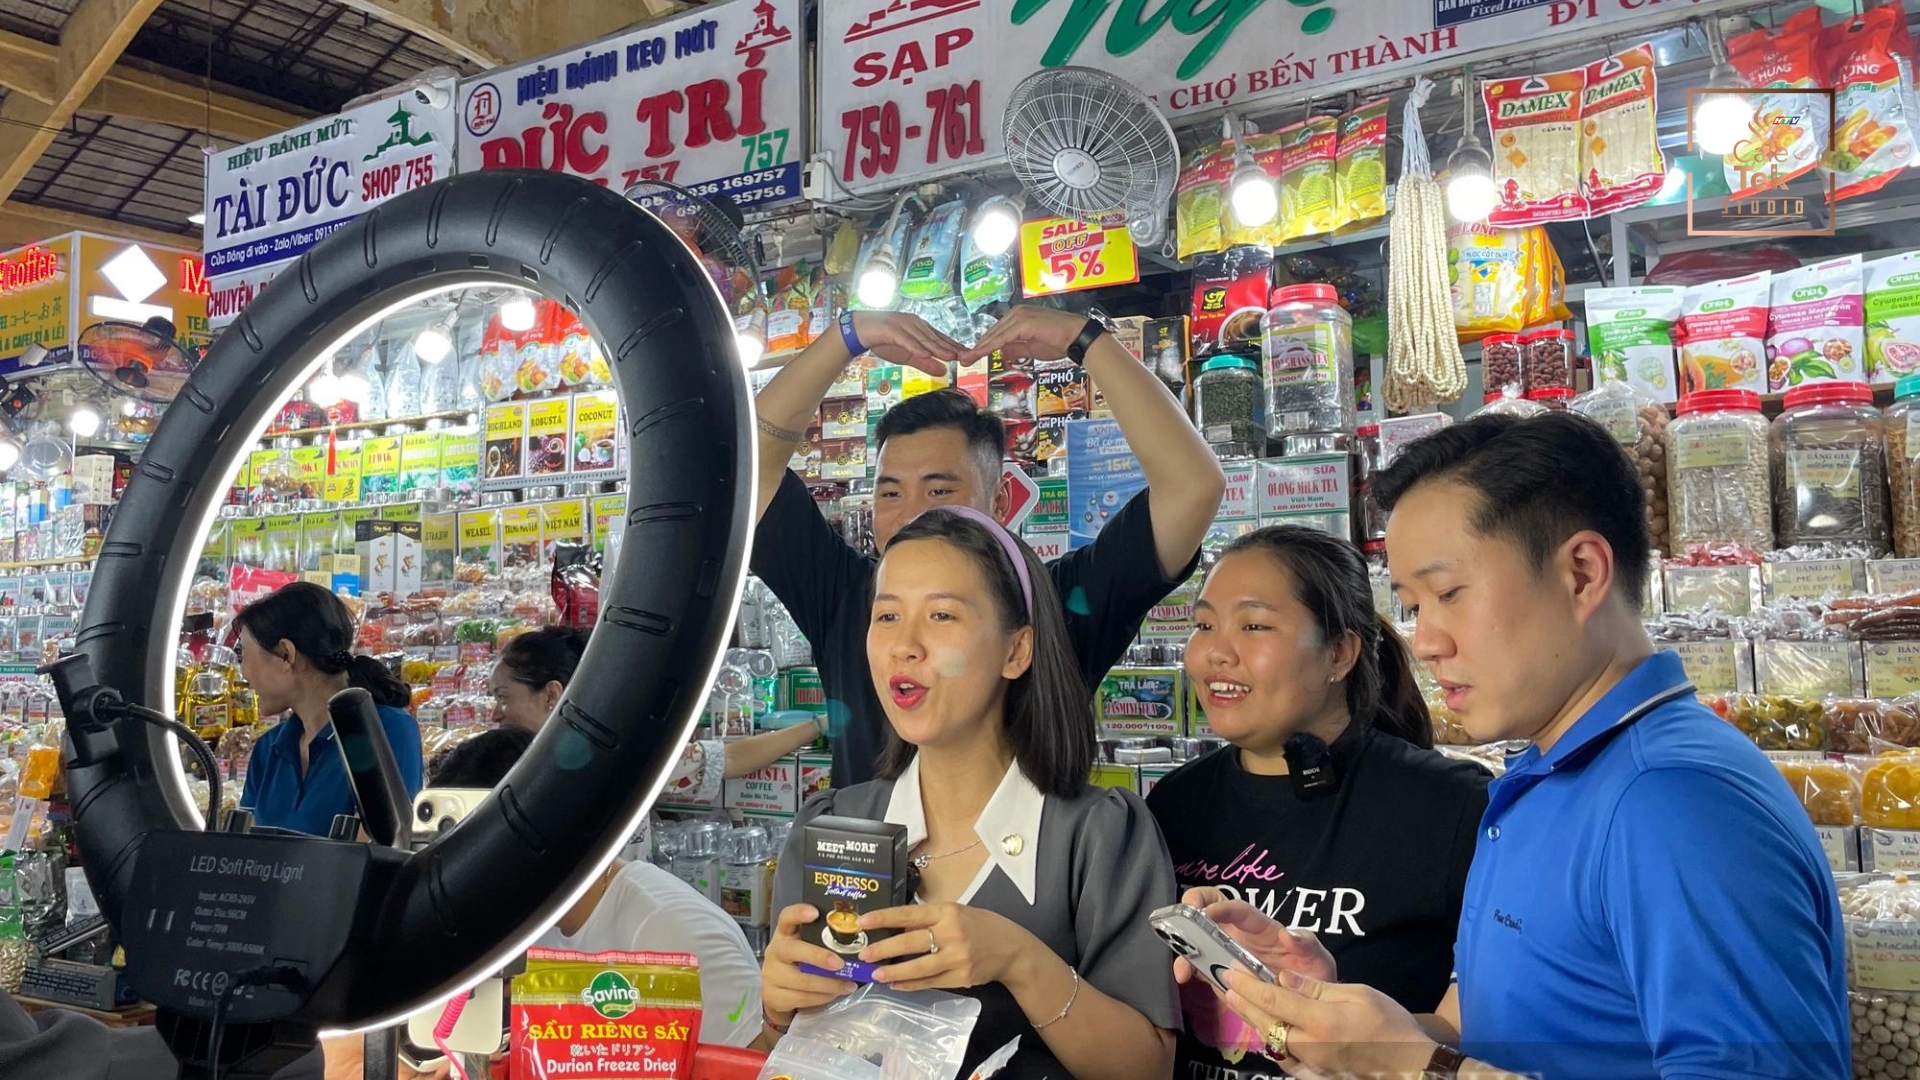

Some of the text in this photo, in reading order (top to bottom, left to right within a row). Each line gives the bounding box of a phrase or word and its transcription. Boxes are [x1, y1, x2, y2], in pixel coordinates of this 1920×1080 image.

[851, 28, 974, 86] SẠP
[1169, 26, 1459, 107] CHỢ BẾN THÀNH
[566, 51, 617, 90] BÁNH
[1585, 69, 1641, 104] DAMEX
[1501, 92, 1569, 117] DAMEX
[227, 118, 353, 170] HIỆU BÁNH MỨT
[741, 128, 790, 173] 757
[361, 154, 433, 202] SHOP 755
[723, 168, 787, 191] 169757
[213, 156, 350, 238] TÀI ĐỨC
[1042, 222, 1088, 239] SALE
[1052, 233, 1088, 252] OFF
[8, 246, 57, 289] coffee
[1051, 249, 1105, 284] 5%
[1204, 290, 1226, 304] G7
[1050, 368, 1074, 384] PHỐ
[488, 419, 523, 432] HIGHLAND
[530, 415, 563, 428] ROBUSTA
[579, 410, 613, 422] COCONUT
[1228, 474, 1249, 483] LOAN
[1321, 478, 1339, 493] TEA
[1225, 487, 1245, 501] TEA
[465, 527, 491, 537] WEASEL
[546, 518, 580, 531] VIỆT NAM
[745, 782, 773, 791] COFFEE
[817, 840, 876, 853] MEET MORE
[190, 855, 216, 874] LED
[217, 857, 243, 877] Soft
[244, 859, 270, 883] Ring
[1221, 843, 1285, 884] like
[814, 872, 879, 892] ESPRESSO
[581, 982, 640, 1006] Savina
[529, 1020, 689, 1041] SẦU RIÊNG SẤY
[546, 1058, 677, 1073] Durian Freeze Dried
